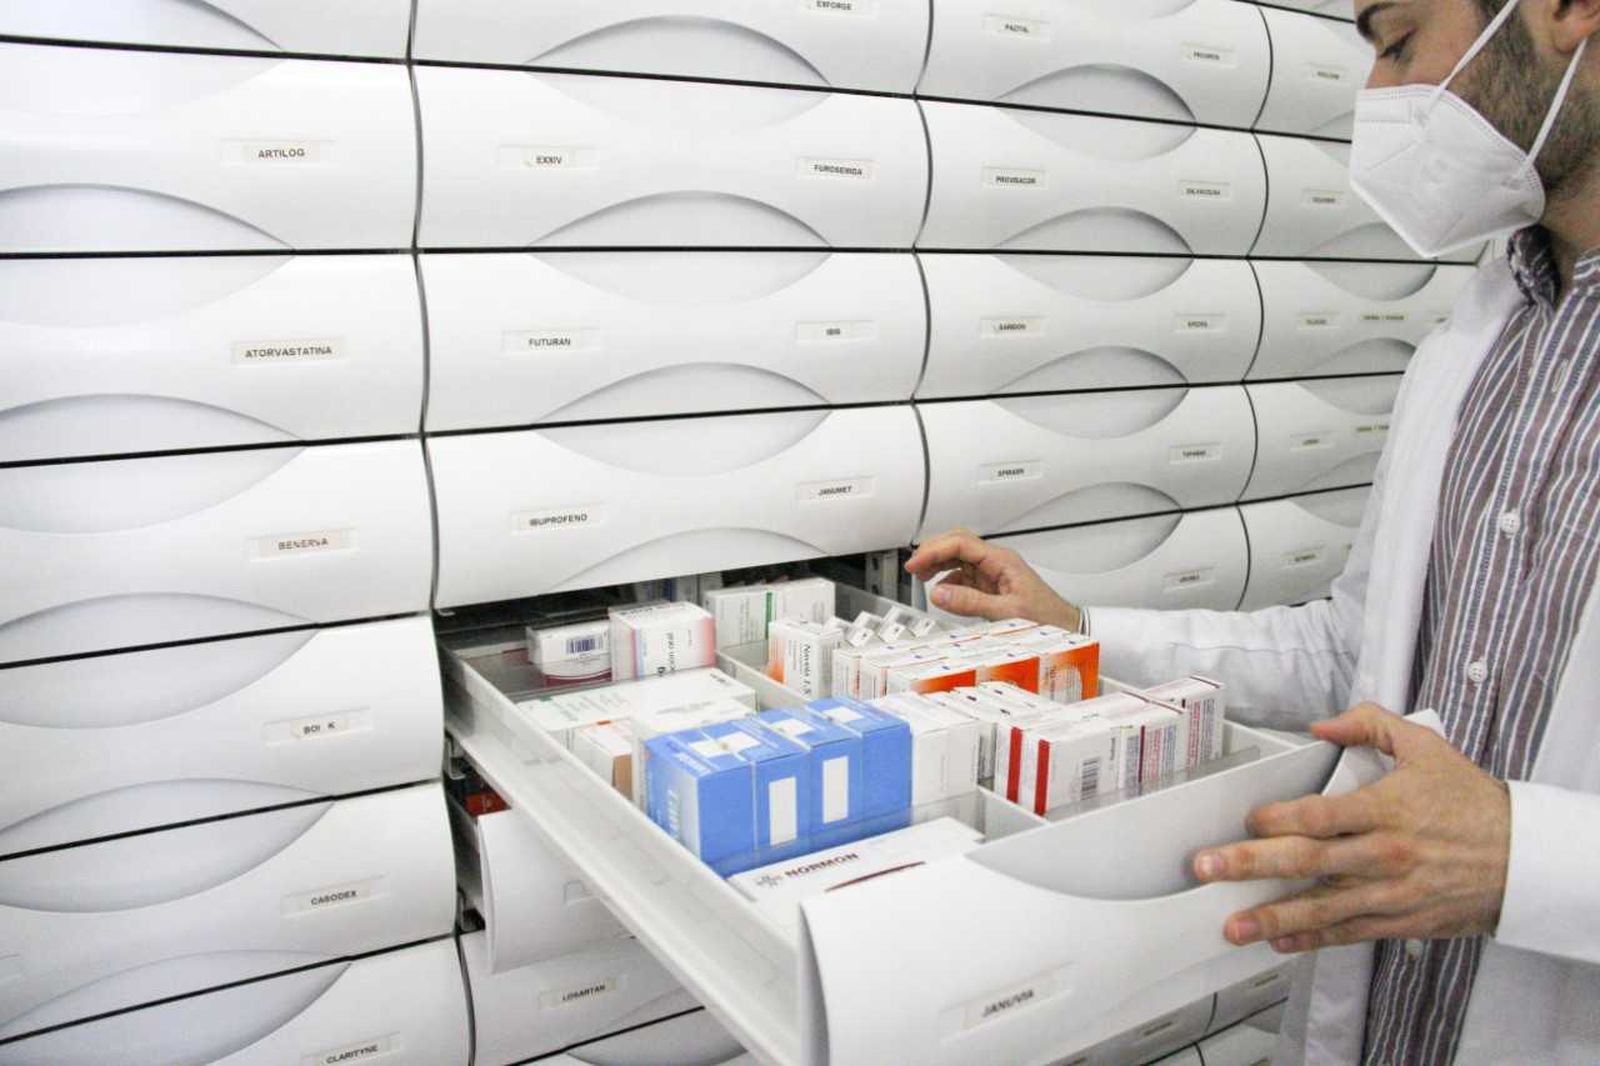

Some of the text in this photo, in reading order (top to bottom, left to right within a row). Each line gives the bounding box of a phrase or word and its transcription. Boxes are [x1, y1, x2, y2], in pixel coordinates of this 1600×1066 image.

[816, 0, 853, 11] EXFORGE
[258, 148, 305, 159] ARTILOG
[528, 337, 571, 347] FUTURAN
[245, 346, 333, 359] ATORVASTATINA
[529, 513, 588, 526] IBUPROFENO
[278, 537, 328, 551] BENERVA
[784, 852, 859, 877] NORMON
[326, 1044, 379, 1064] CLARITYNE
